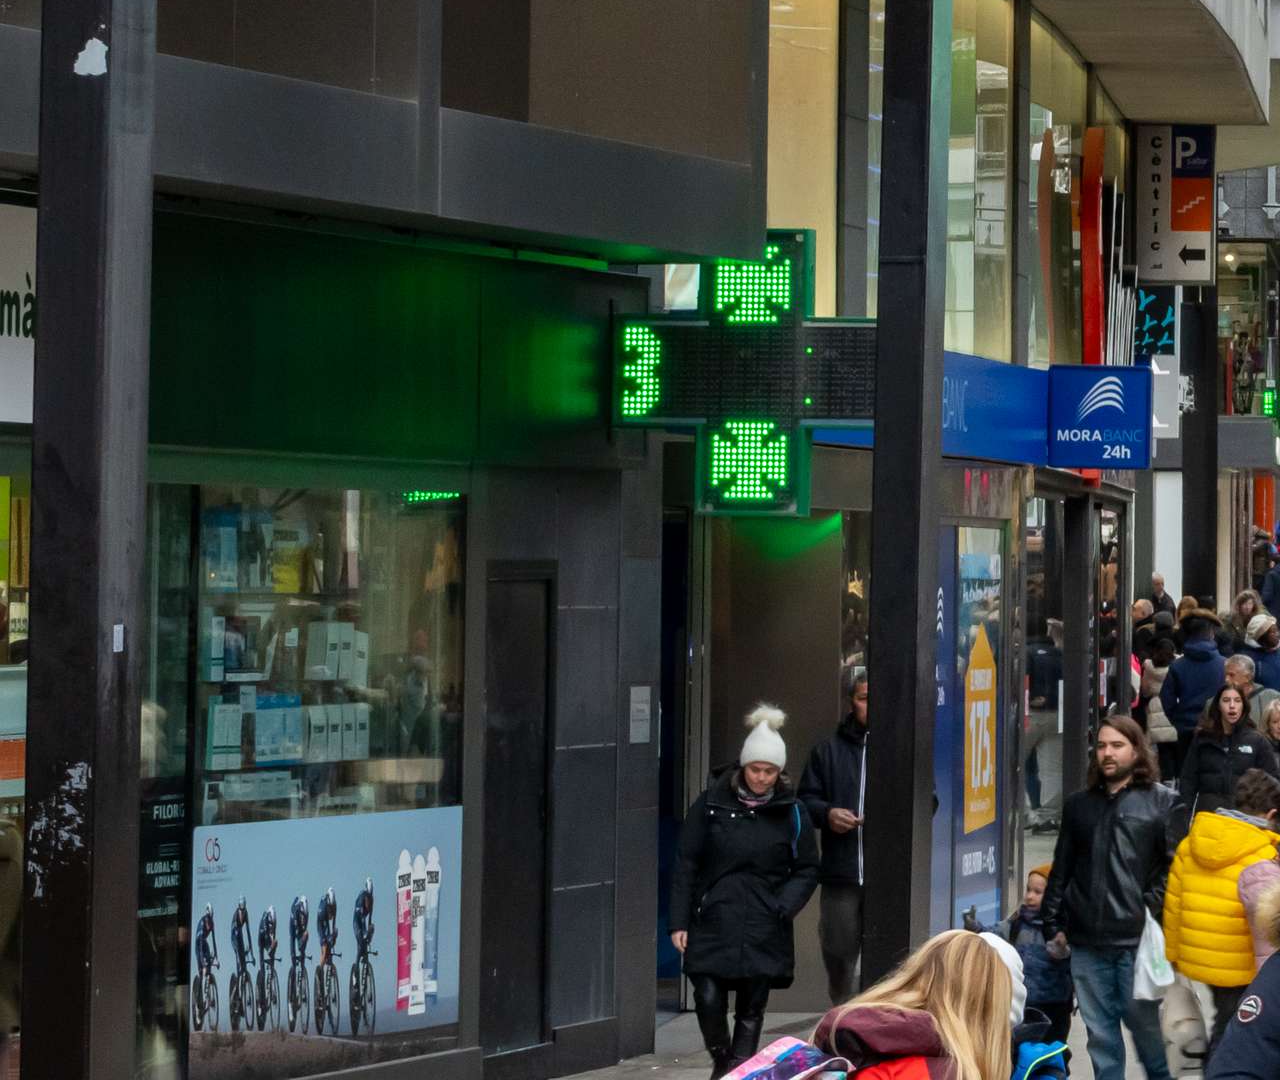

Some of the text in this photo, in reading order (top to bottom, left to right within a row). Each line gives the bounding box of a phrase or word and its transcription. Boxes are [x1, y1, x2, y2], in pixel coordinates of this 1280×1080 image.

[1174, 135, 1198, 170] P
[1150, 134, 1164, 253] Cèntric
[1056, 428, 1144, 442] MORABANC
[1102, 444, 1132, 459] 24h
